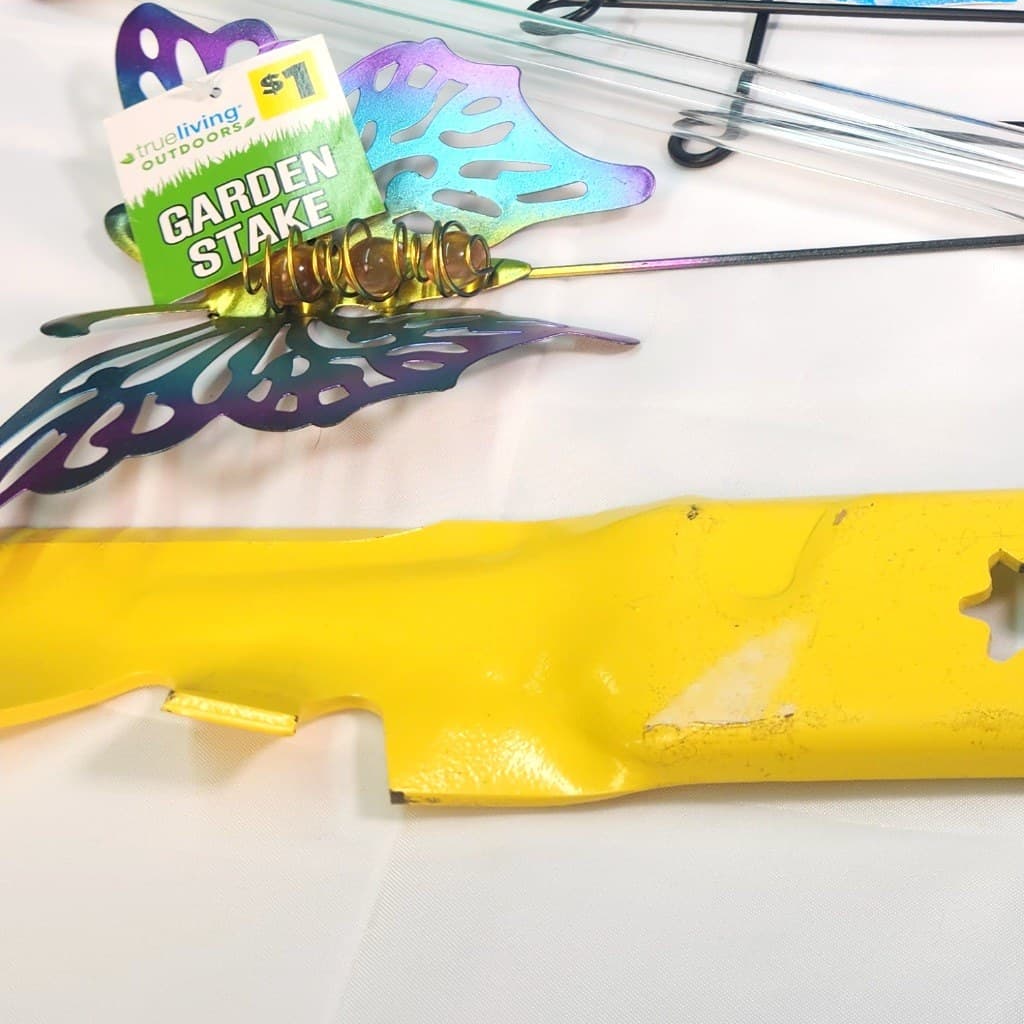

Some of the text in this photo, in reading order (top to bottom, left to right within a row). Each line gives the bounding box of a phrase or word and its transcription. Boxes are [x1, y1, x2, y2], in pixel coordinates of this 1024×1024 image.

[259, 60, 317, 100] $1
[141, 122, 242, 172] OUTDOORS
[157, 144, 340, 246] GARDEN
[186, 188, 334, 280] STAKE
